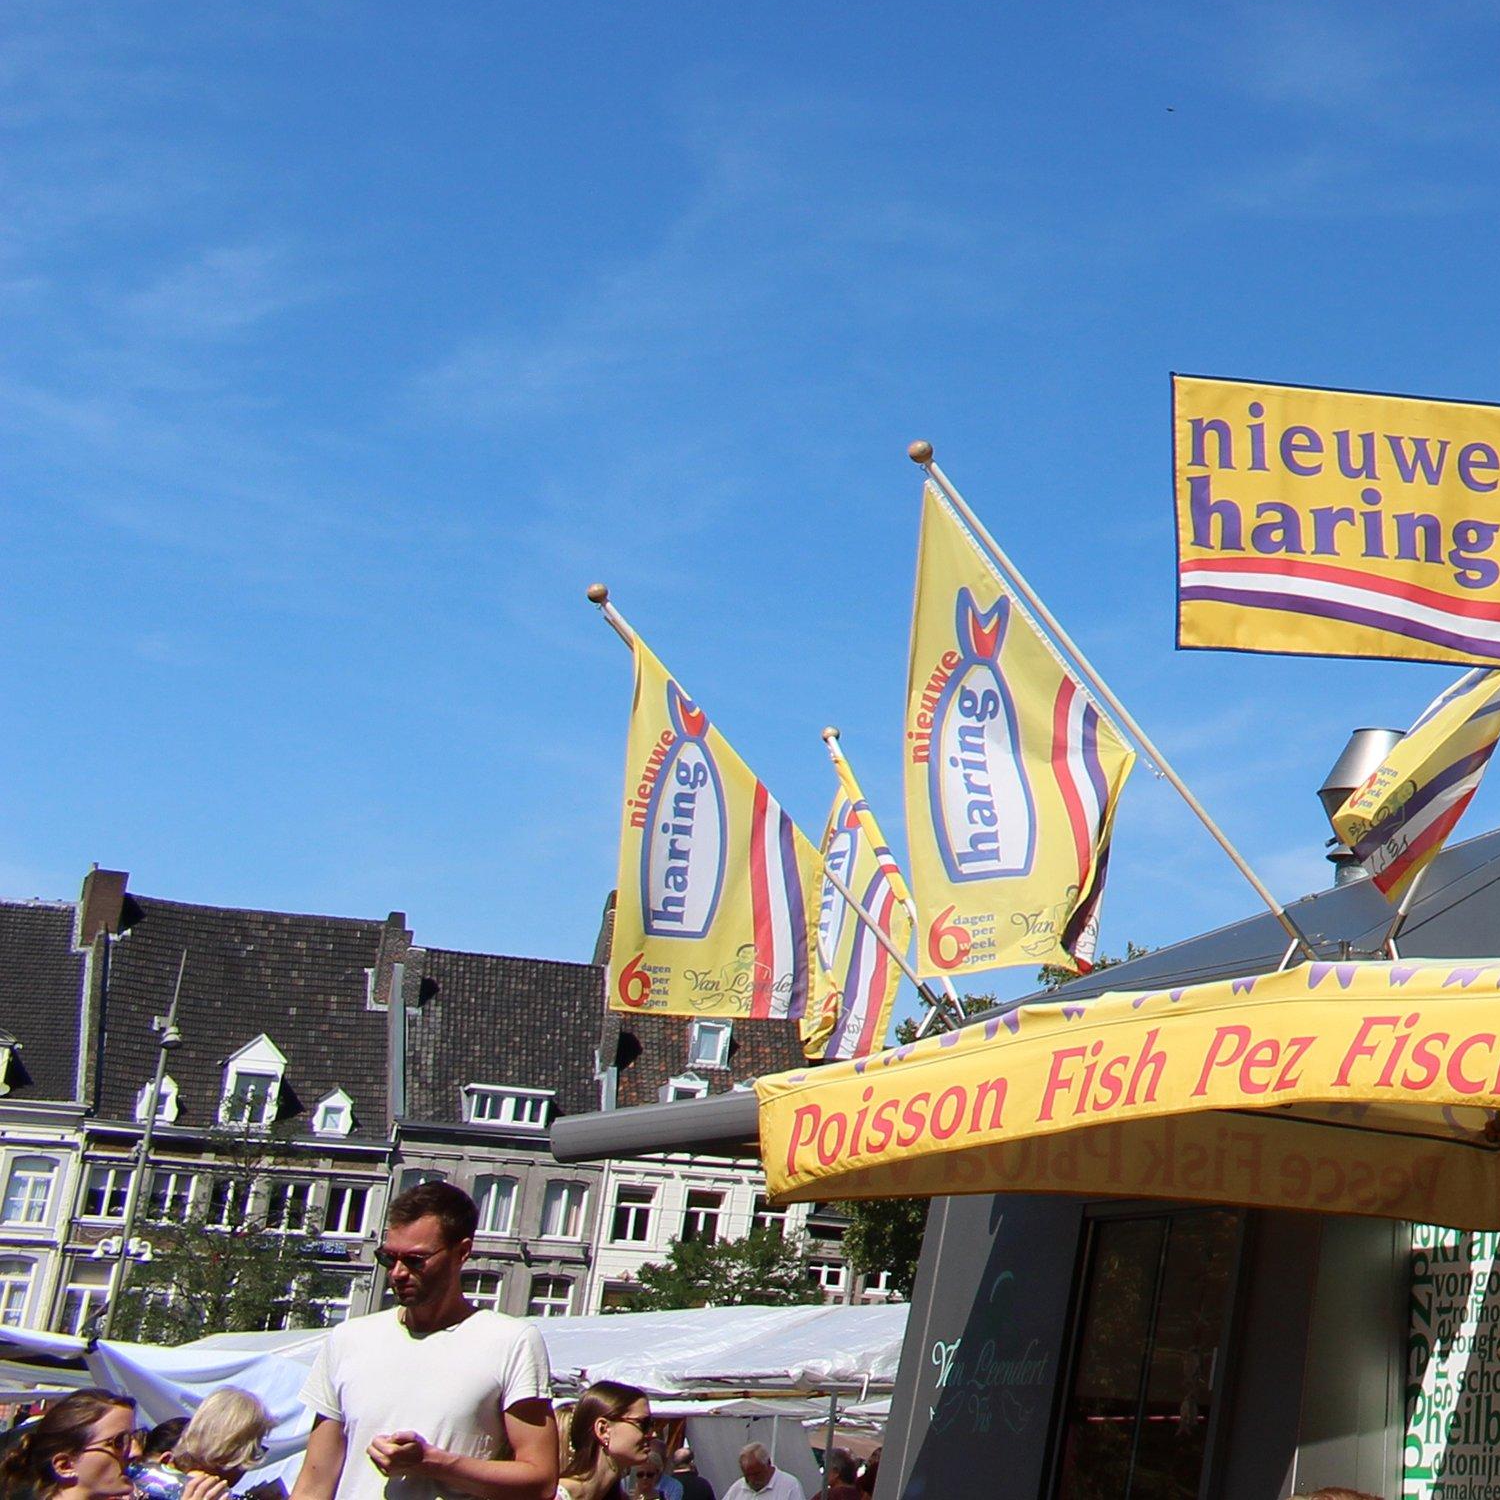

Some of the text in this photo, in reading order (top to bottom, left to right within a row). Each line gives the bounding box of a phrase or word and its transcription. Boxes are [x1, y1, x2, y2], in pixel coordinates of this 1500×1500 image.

[1187, 401, 1500, 493] nieuwe
[1186, 474, 1500, 590] haring
[907, 649, 961, 765] nieuwe
[627, 729, 676, 830] nieuwe
[949, 685, 1001, 867] haring
[652, 758, 709, 925] haring
[928, 904, 971, 970] 6
[953, 914, 995, 927] dagen
[971, 927, 995, 938] per
[1010, 911, 1055, 936] Van
[618, 952, 652, 1007] 6
[641, 962, 671, 974] dagen
[652, 976, 670, 987] per
[683, 969, 720, 992] Van
[786, 1076, 1008, 1178] Poisson
[1035, 1027, 1167, 1123] Fish
[1190, 1025, 1318, 1097] Pez
[932, 1338, 964, 1389] Van
